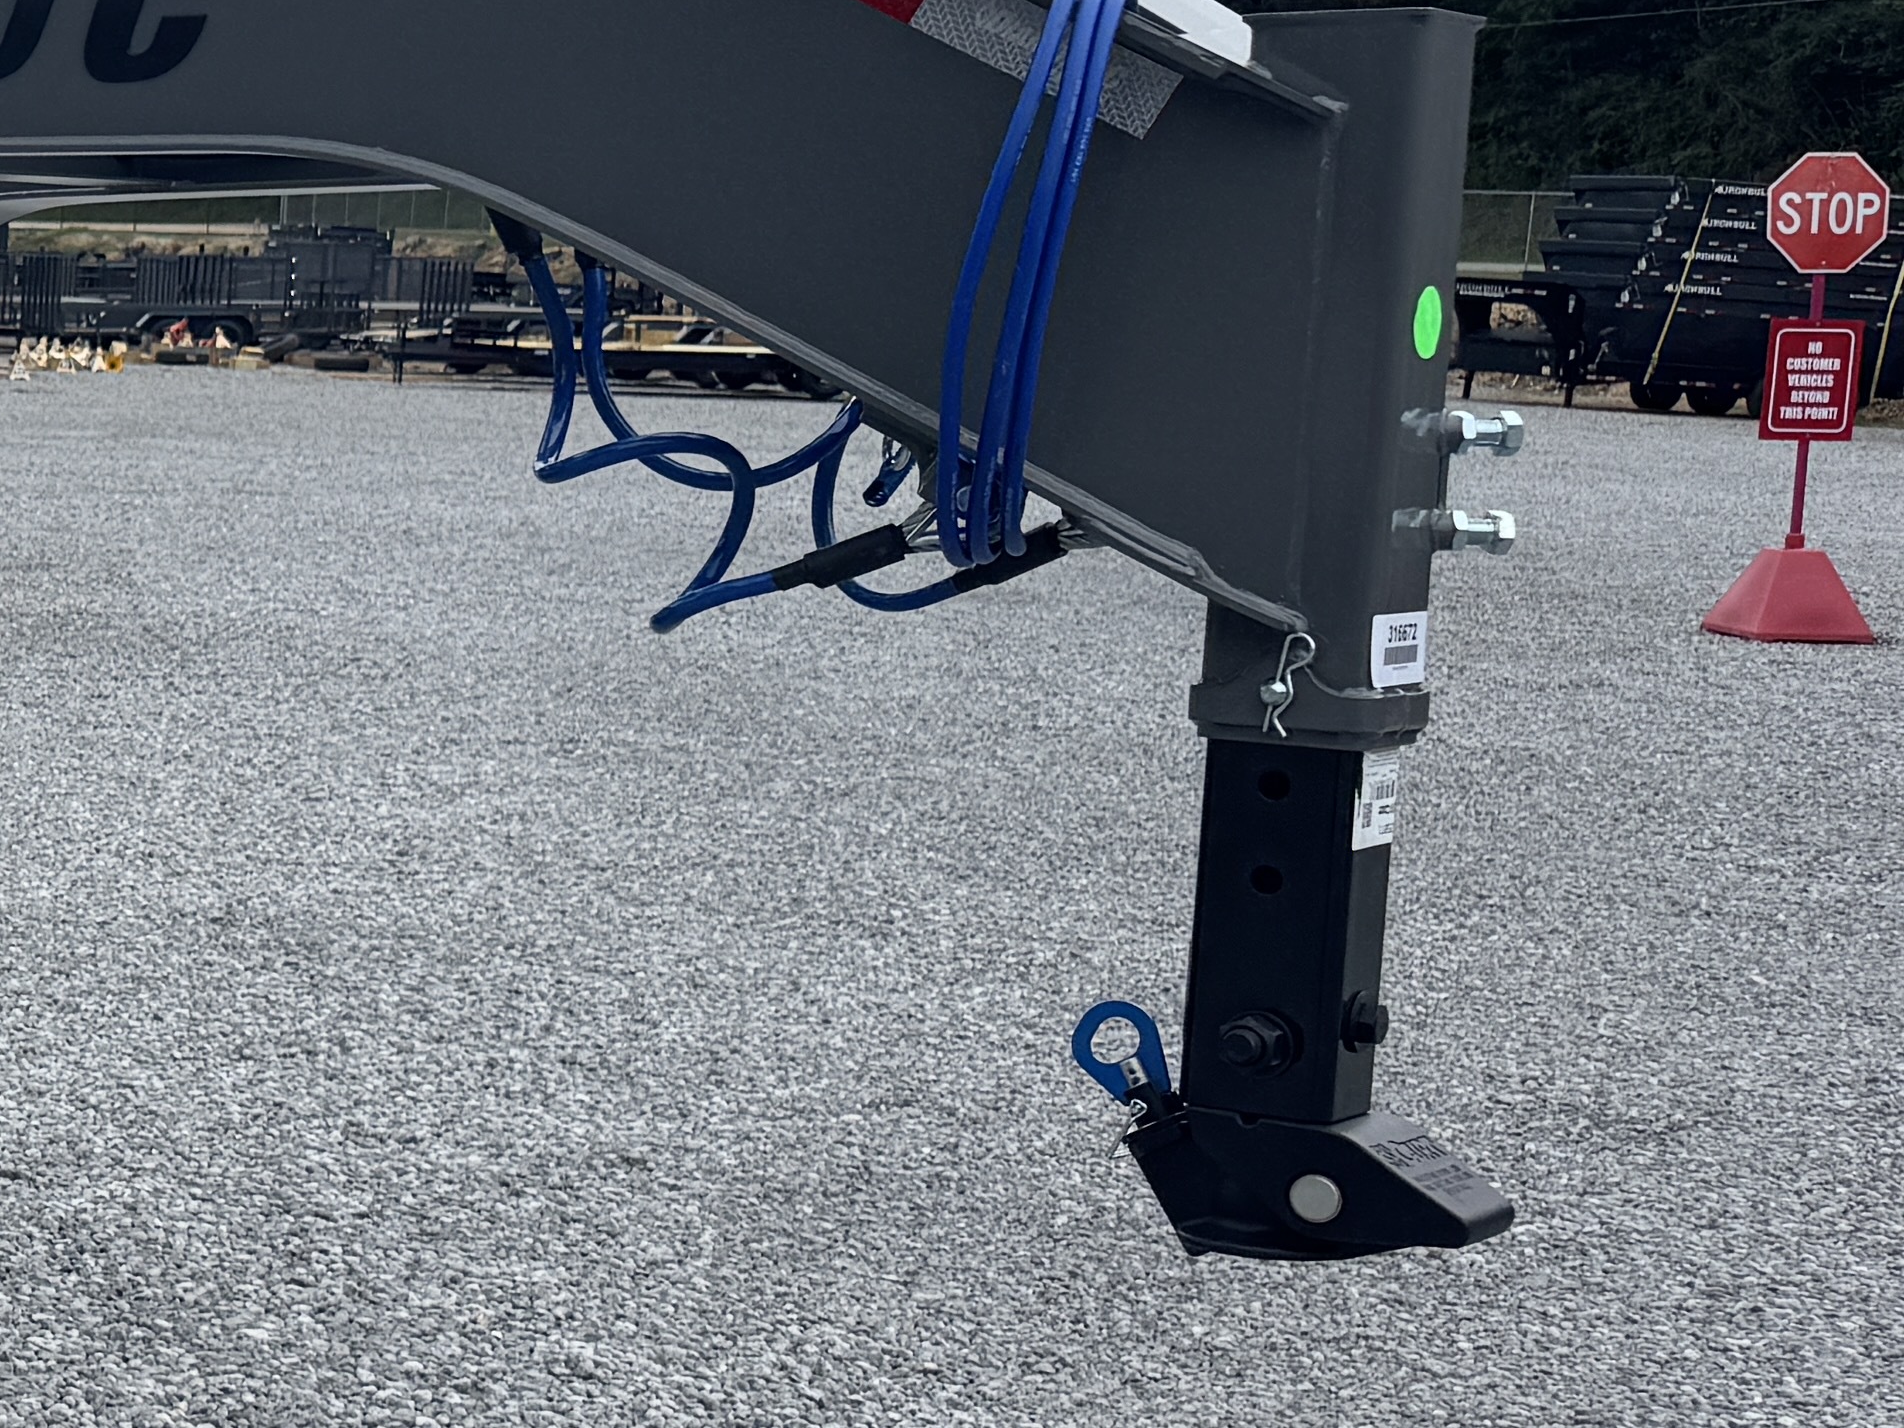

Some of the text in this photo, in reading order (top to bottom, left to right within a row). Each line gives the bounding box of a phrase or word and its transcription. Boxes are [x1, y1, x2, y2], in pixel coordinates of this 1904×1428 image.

[1776, 191, 1881, 235] STOP
[1808, 341, 1823, 354] NO
[1786, 357, 1841, 371] CUSTOMER
[1787, 373, 1834, 387] VEHICLES
[1790, 390, 1830, 403] BEYOND
[1779, 406, 1839, 420] THIS POINT!
